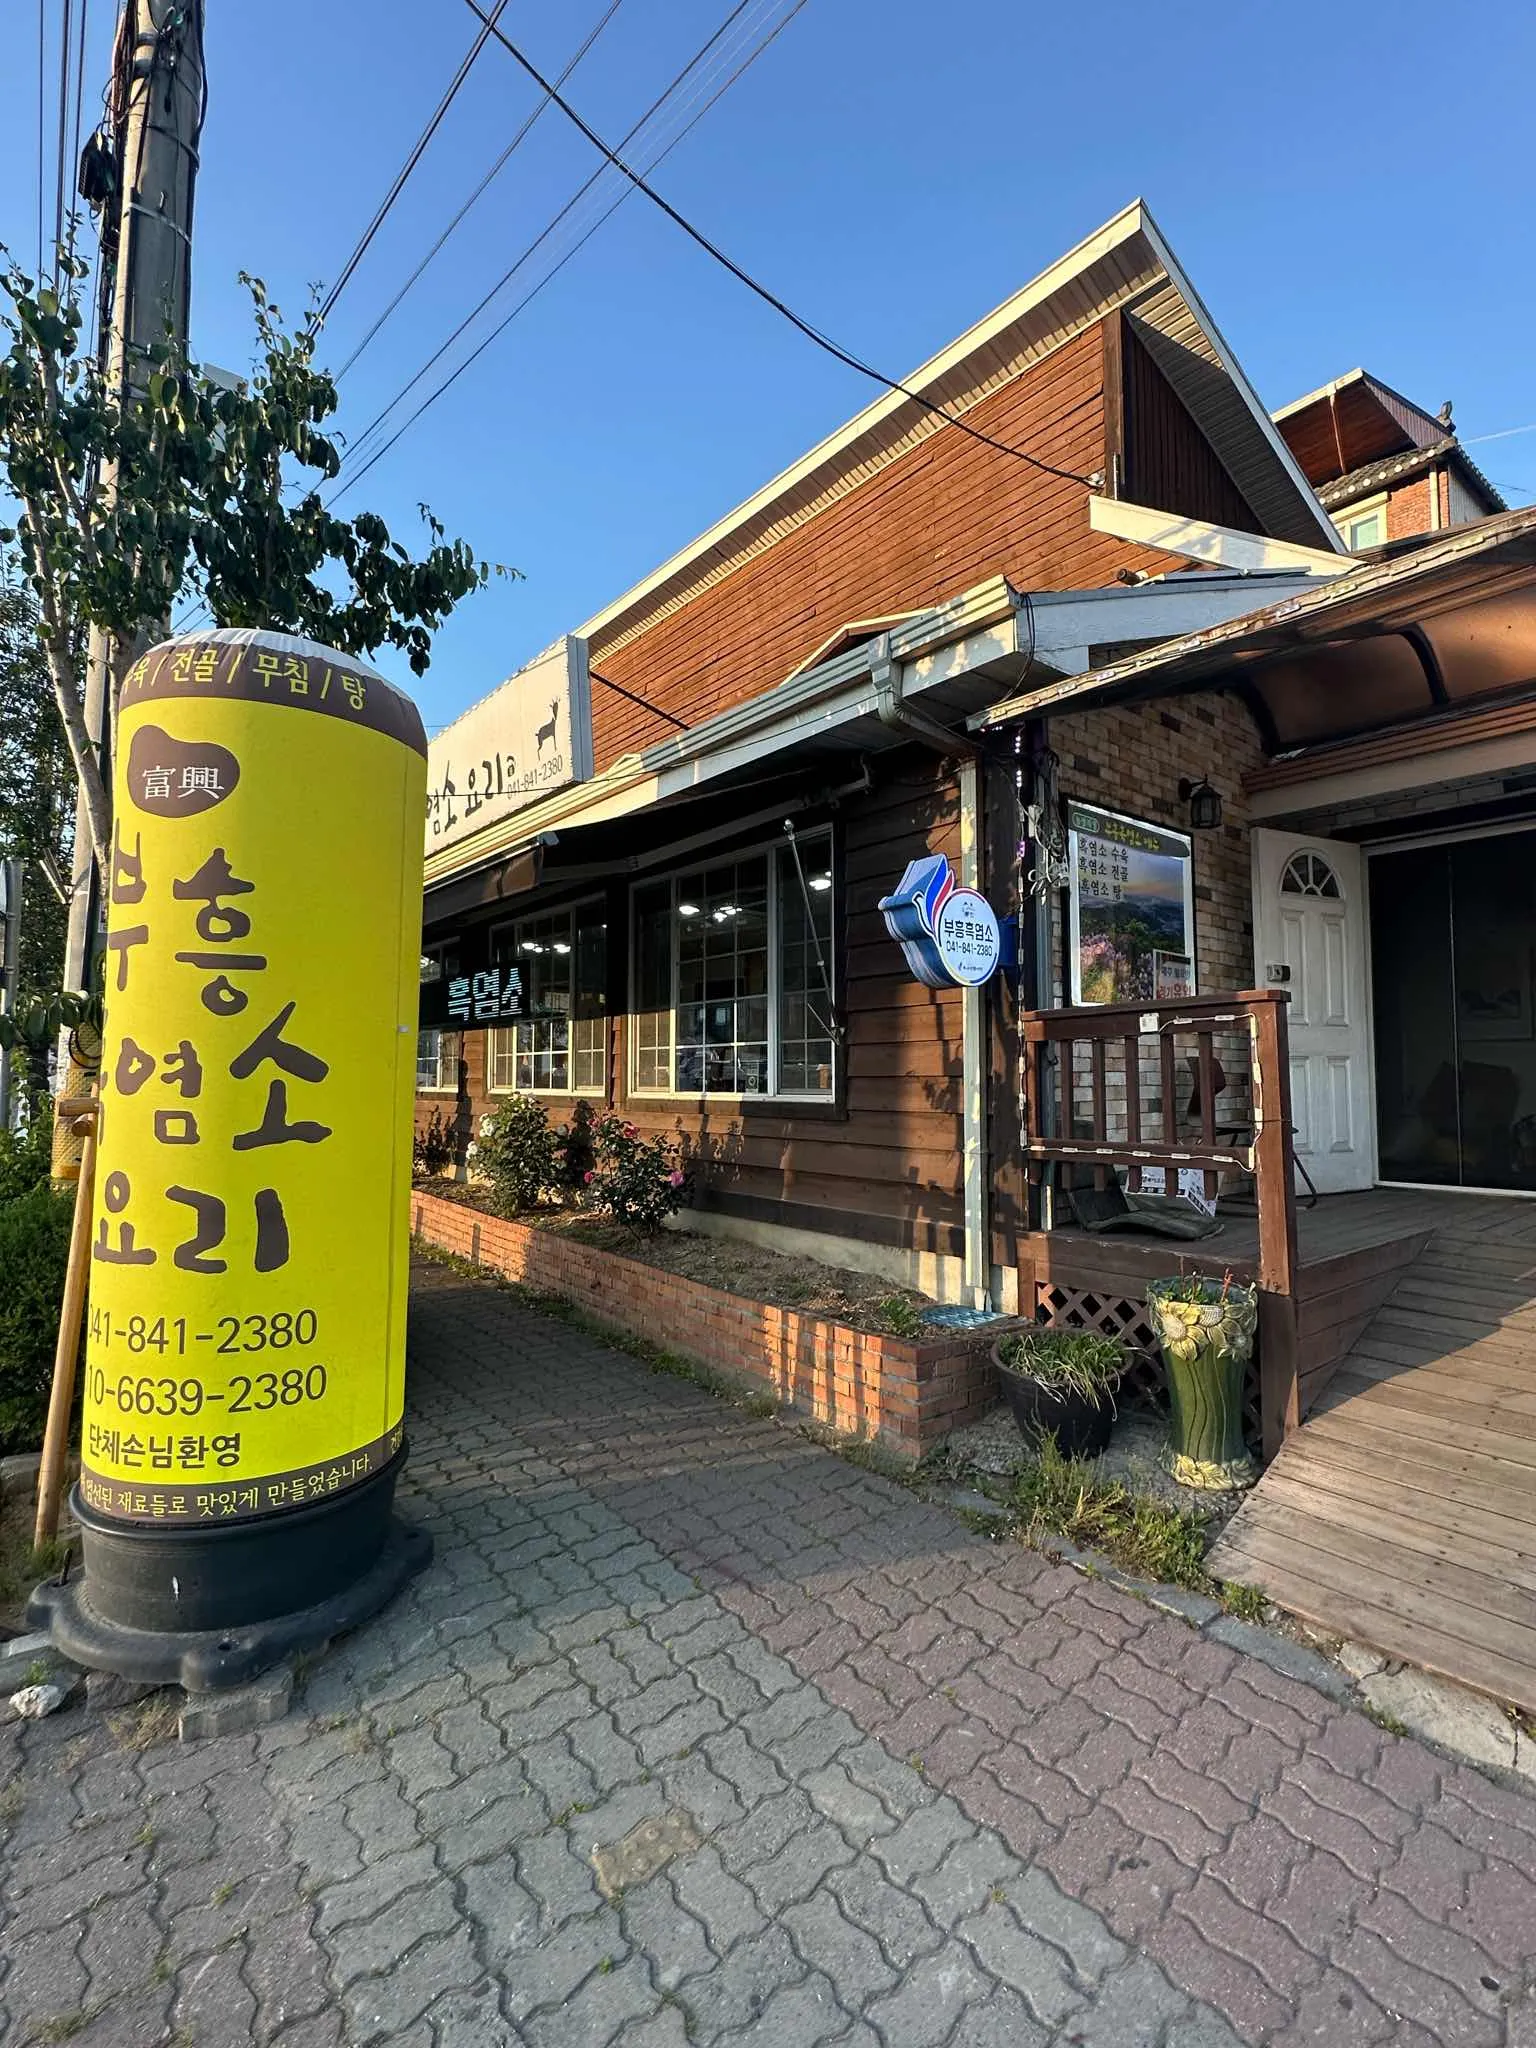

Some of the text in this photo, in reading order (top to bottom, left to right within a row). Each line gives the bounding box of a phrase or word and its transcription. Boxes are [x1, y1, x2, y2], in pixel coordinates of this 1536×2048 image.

[170, 648, 220, 683] 전골
[253, 653, 309, 695] 무침
[341, 675, 367, 710] 탕
[141, 765, 224, 800] 富興
[108, 817, 267, 1016] 부흥
[944, 919, 993, 943] 부흥흑염소
[946, 941, 993, 957] 041-841-2380
[448, 967, 523, 1021] 흑염소
[98, 1001, 333, 1151] 염소
[93, 1170, 289, 1274] 요리
[86, 1364, 328, 1417] 10-6639-2380
[88, 1423, 242, 1469] 단체손님환영
[117, 1490, 189, 1518] 재료들로
[197, 1487, 259, 1516] 맛있게
[267, 1454, 373, 1507] 만들었습니다.
